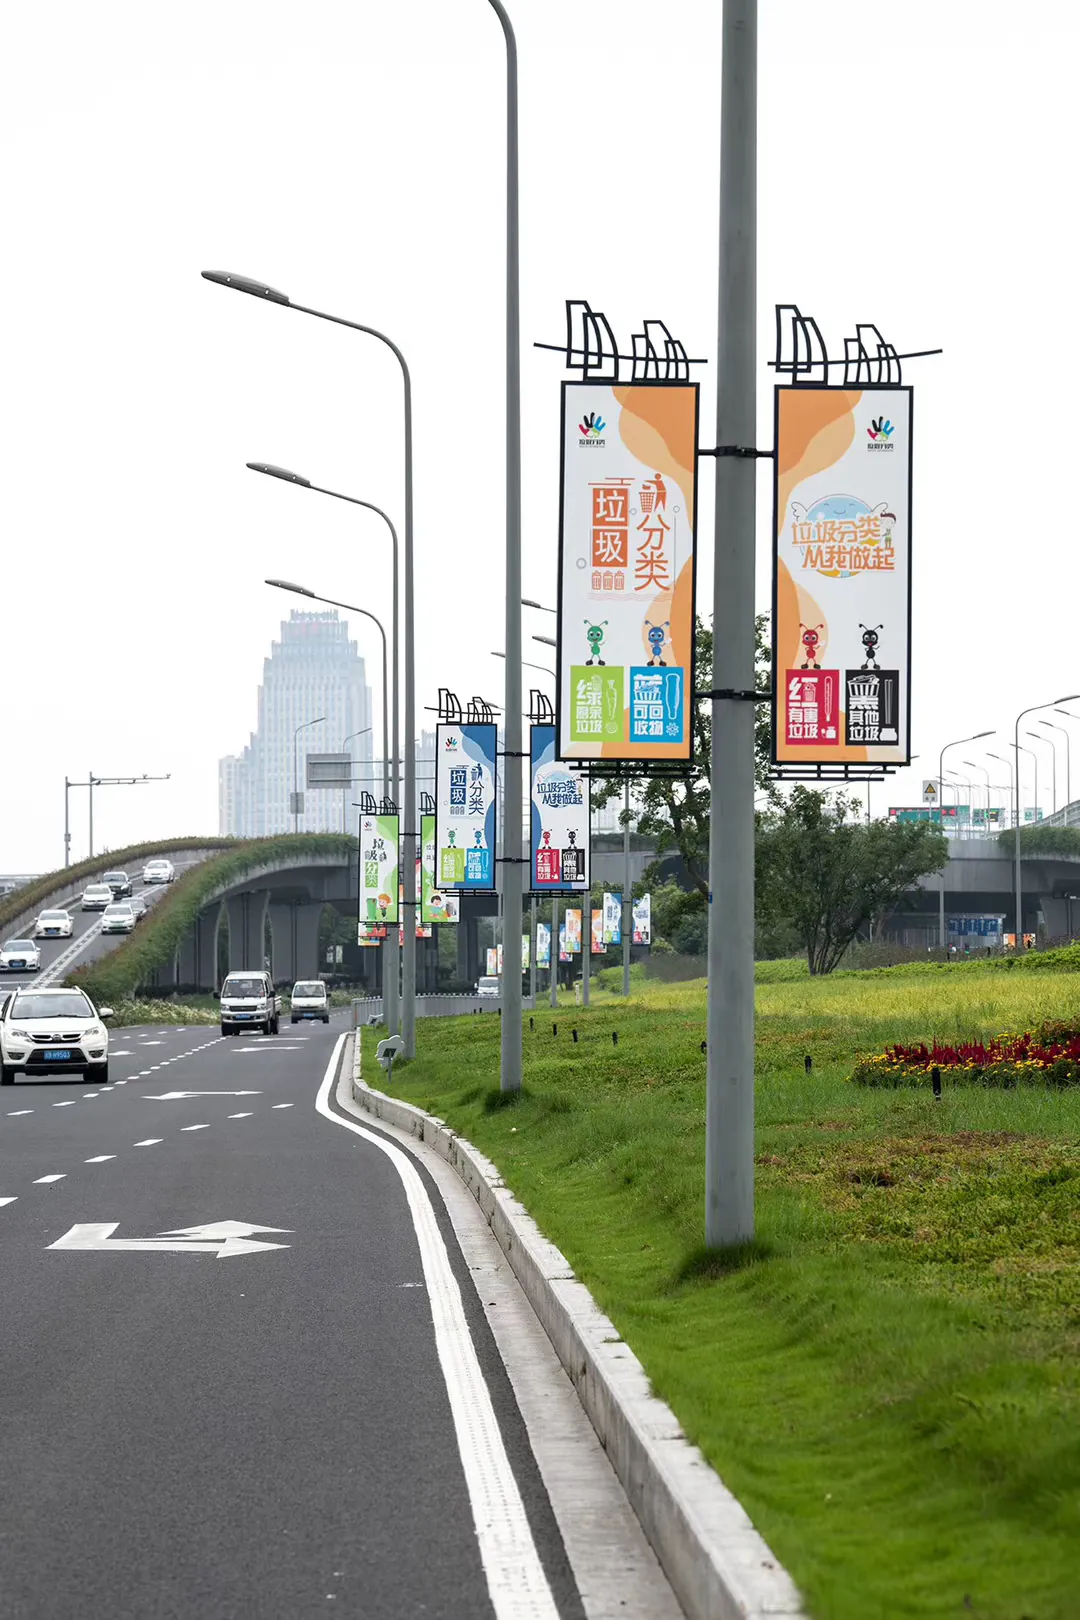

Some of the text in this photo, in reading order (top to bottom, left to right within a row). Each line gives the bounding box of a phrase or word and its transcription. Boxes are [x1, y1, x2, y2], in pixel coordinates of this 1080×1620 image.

[594, 489, 627, 565] 垃圾
[791, 516, 880, 545] 垃圾分类
[635, 514, 670, 591] 分类
[802, 545, 895, 571] 从我做起
[633, 705, 664, 719] 可回
[788, 708, 818, 723] 有害
[849, 710, 880, 725] 其他
[633, 720, 664, 735] 收物
[788, 724, 818, 739] 垃圾
[849, 726, 880, 741] 垃圾
[451, 770, 466, 804] 垃圾
[537, 780, 576, 794] 垃圾分类
[468, 780, 485, 815] 分类
[542, 793, 584, 805] 从我做起
